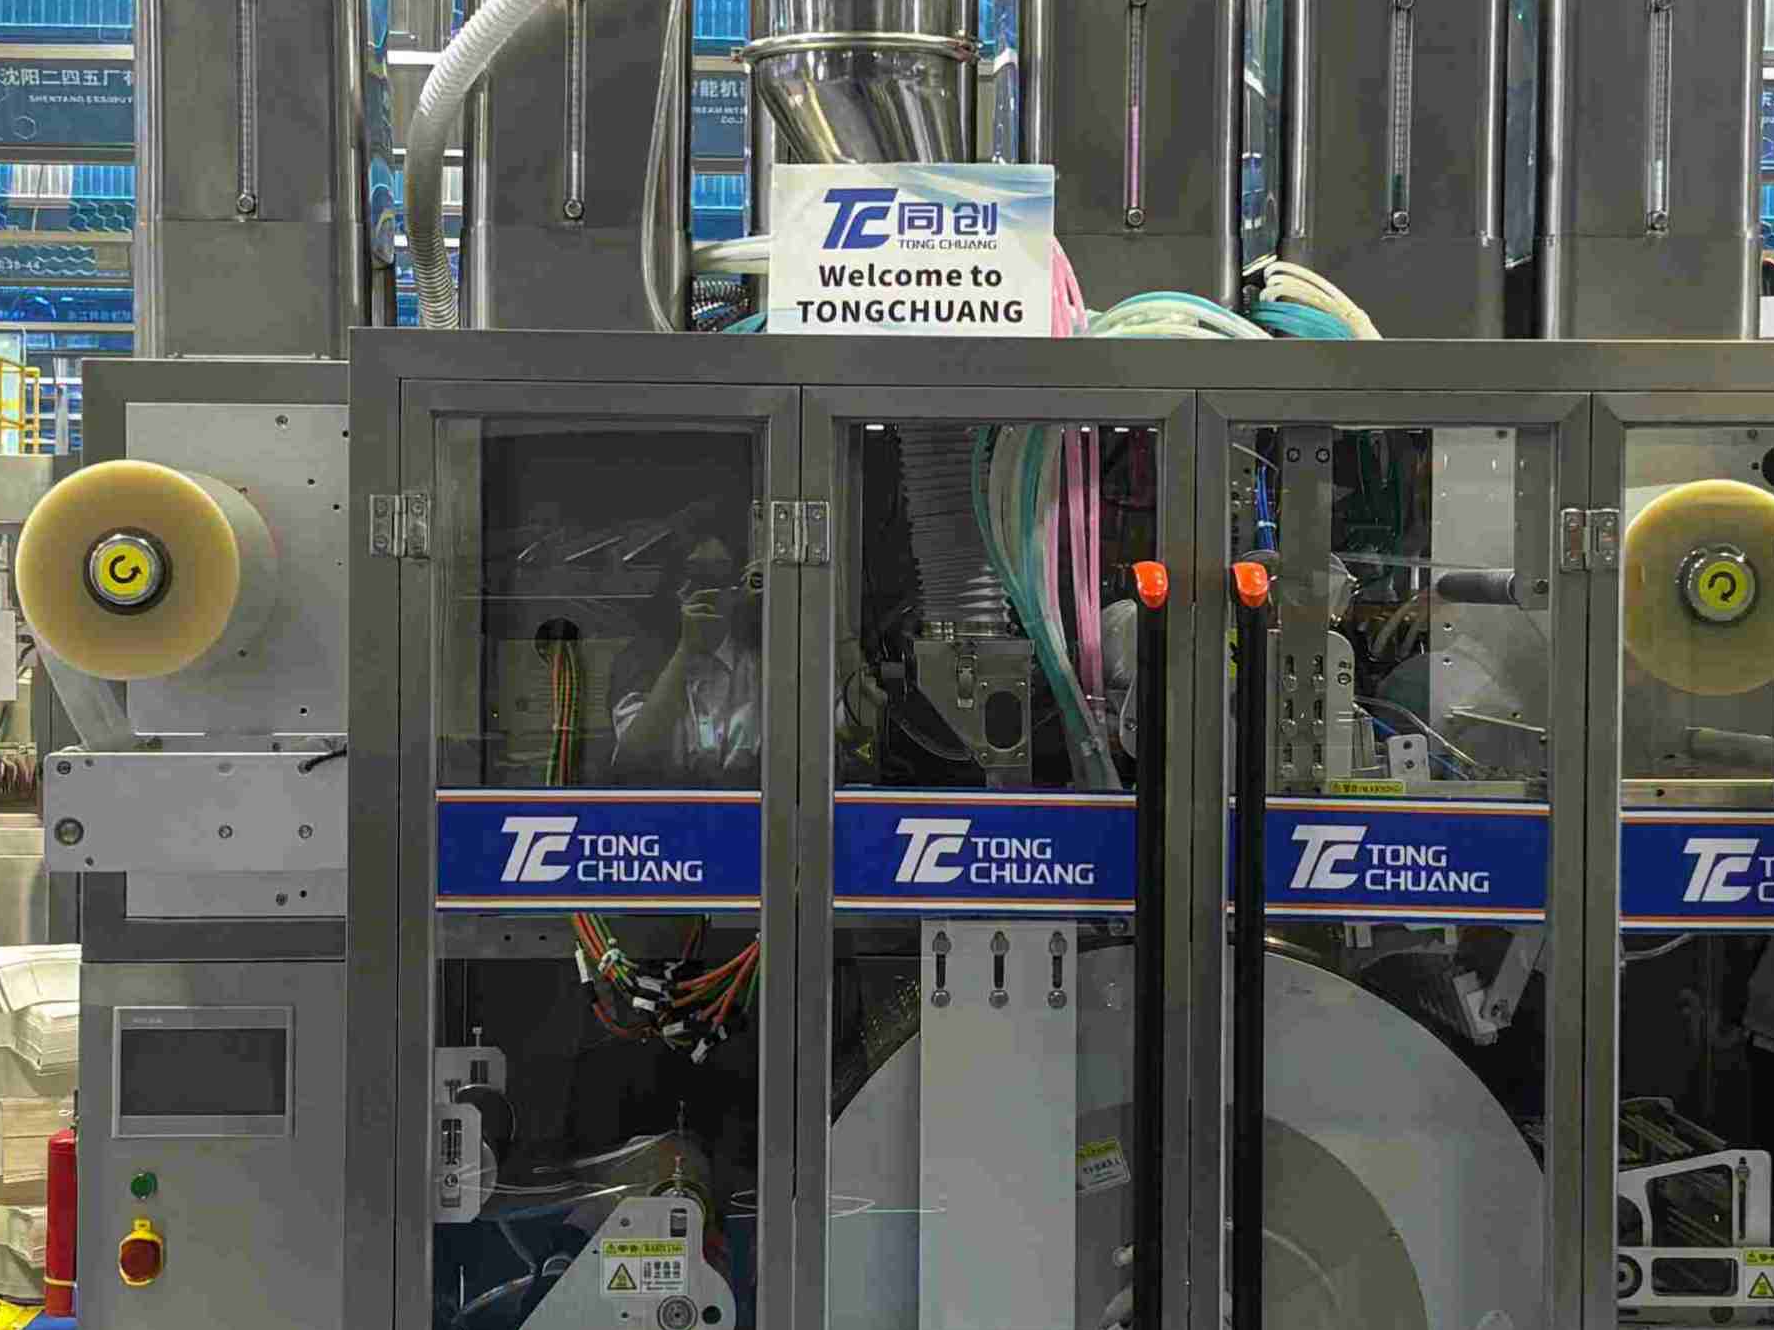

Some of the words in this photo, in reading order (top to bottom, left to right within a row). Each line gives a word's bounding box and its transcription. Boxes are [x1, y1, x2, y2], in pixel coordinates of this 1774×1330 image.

[897, 201, 998, 236] 同创
[899, 238, 936, 251] TONG
[939, 238, 998, 251] CHUANG
[818, 263, 962, 288] Welcome
[971, 265, 1003, 288] to
[796, 299, 1025, 324] TONGCHUANG
[577, 835, 660, 858] TONG
[970, 837, 1052, 859] TONG
[1365, 844, 1448, 867] TONG
[577, 859, 703, 882] CHUANG
[970, 861, 1095, 885] CHUANG
[1365, 869, 1490, 894] CHUANG
